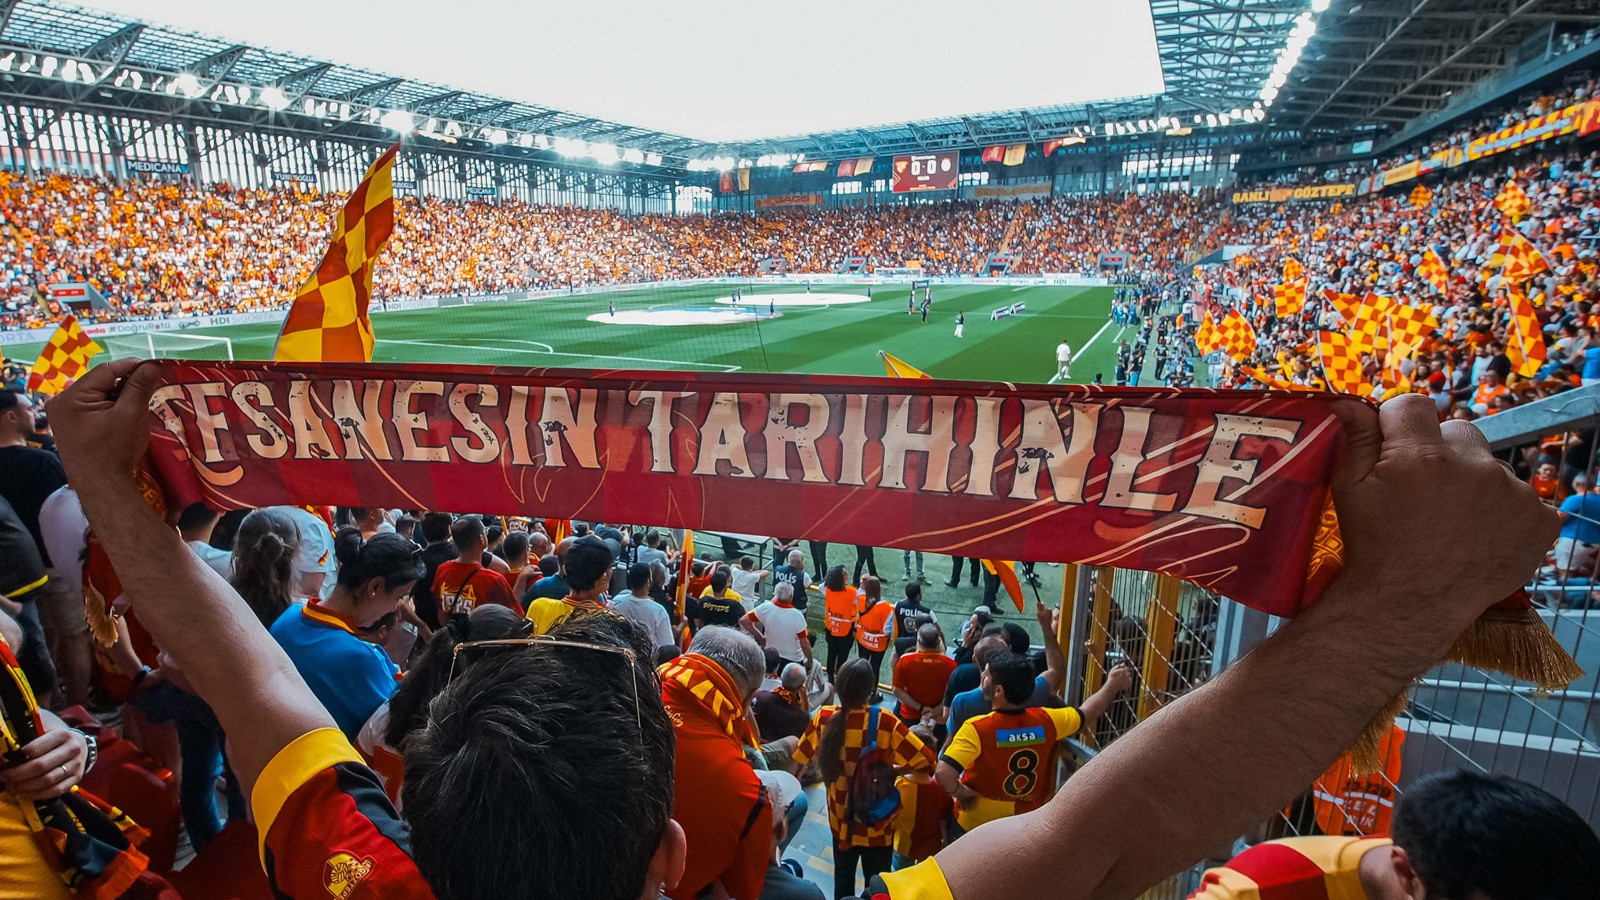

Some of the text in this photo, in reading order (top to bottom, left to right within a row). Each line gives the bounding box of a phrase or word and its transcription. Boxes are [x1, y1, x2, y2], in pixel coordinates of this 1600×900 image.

[128, 161, 181, 173] MEDICANA
[210, 317, 230, 326] HDI
[775, 571, 797, 584] POLİS
[1003, 748, 1040, 797] 8
